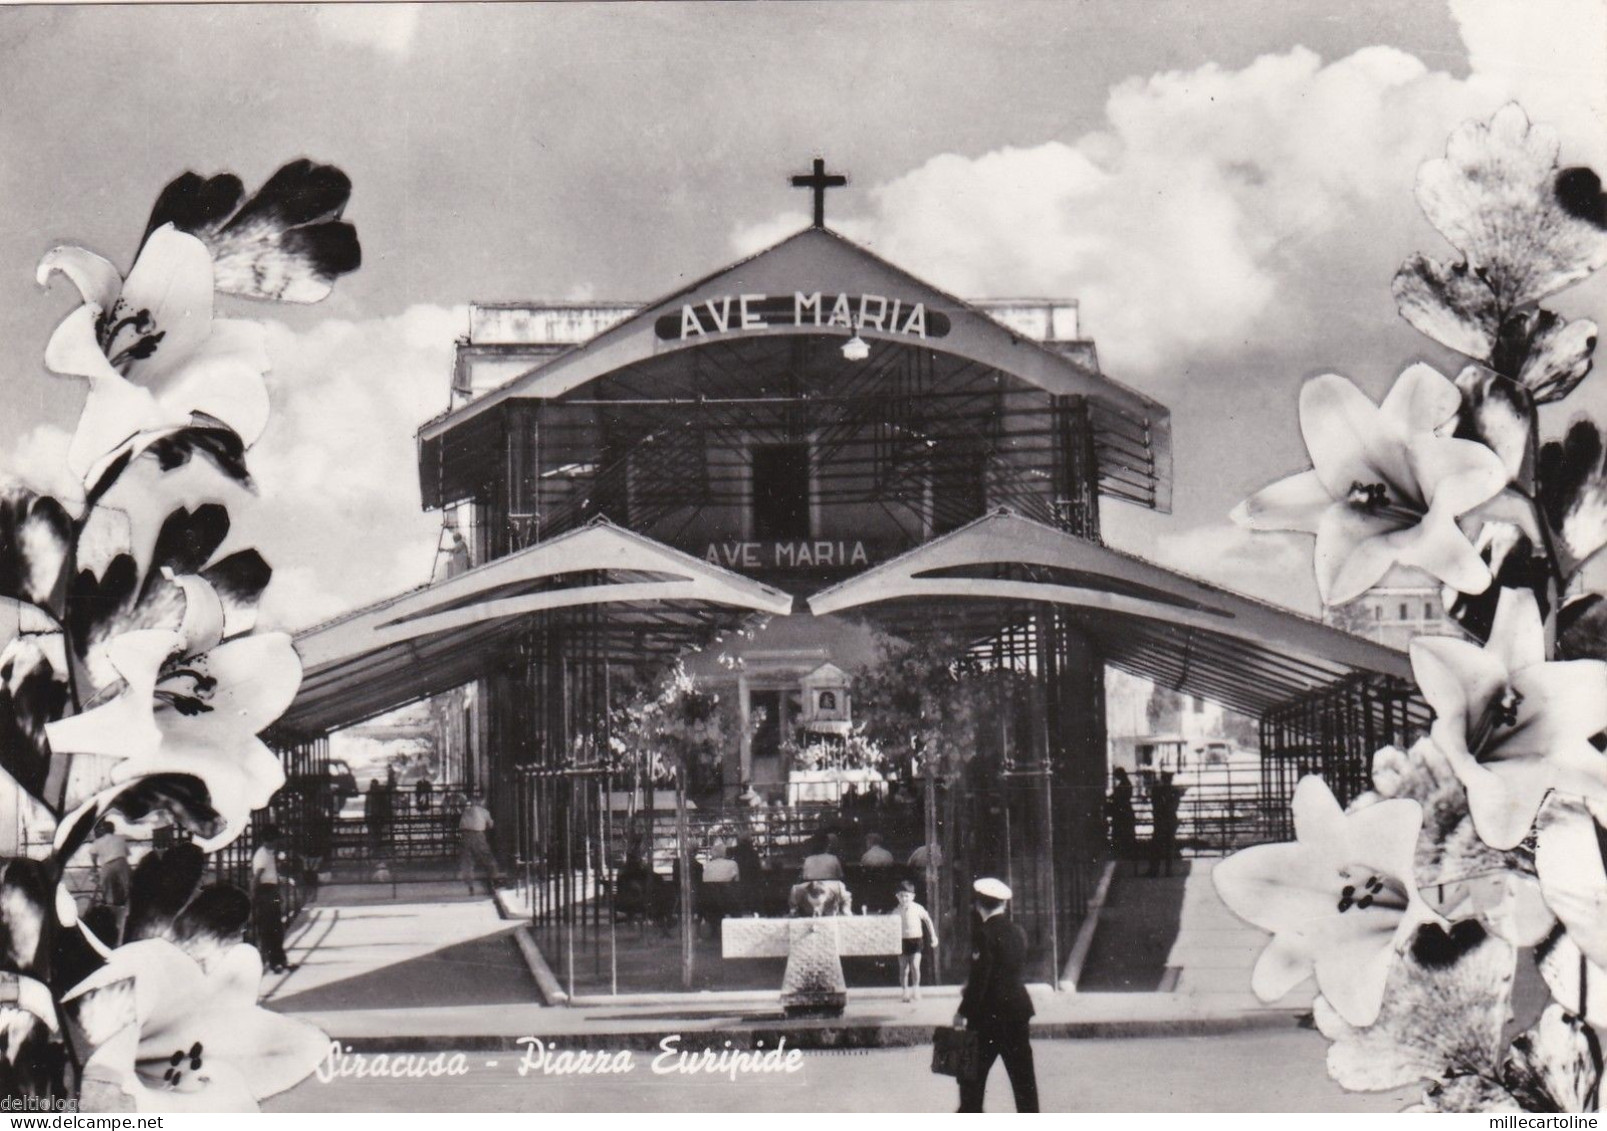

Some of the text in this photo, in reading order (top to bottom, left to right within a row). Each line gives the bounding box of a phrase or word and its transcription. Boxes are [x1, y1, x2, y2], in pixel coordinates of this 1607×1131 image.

[681, 292, 926, 340] AVE MARIA
[705, 541, 868, 567] AVE MARIA
